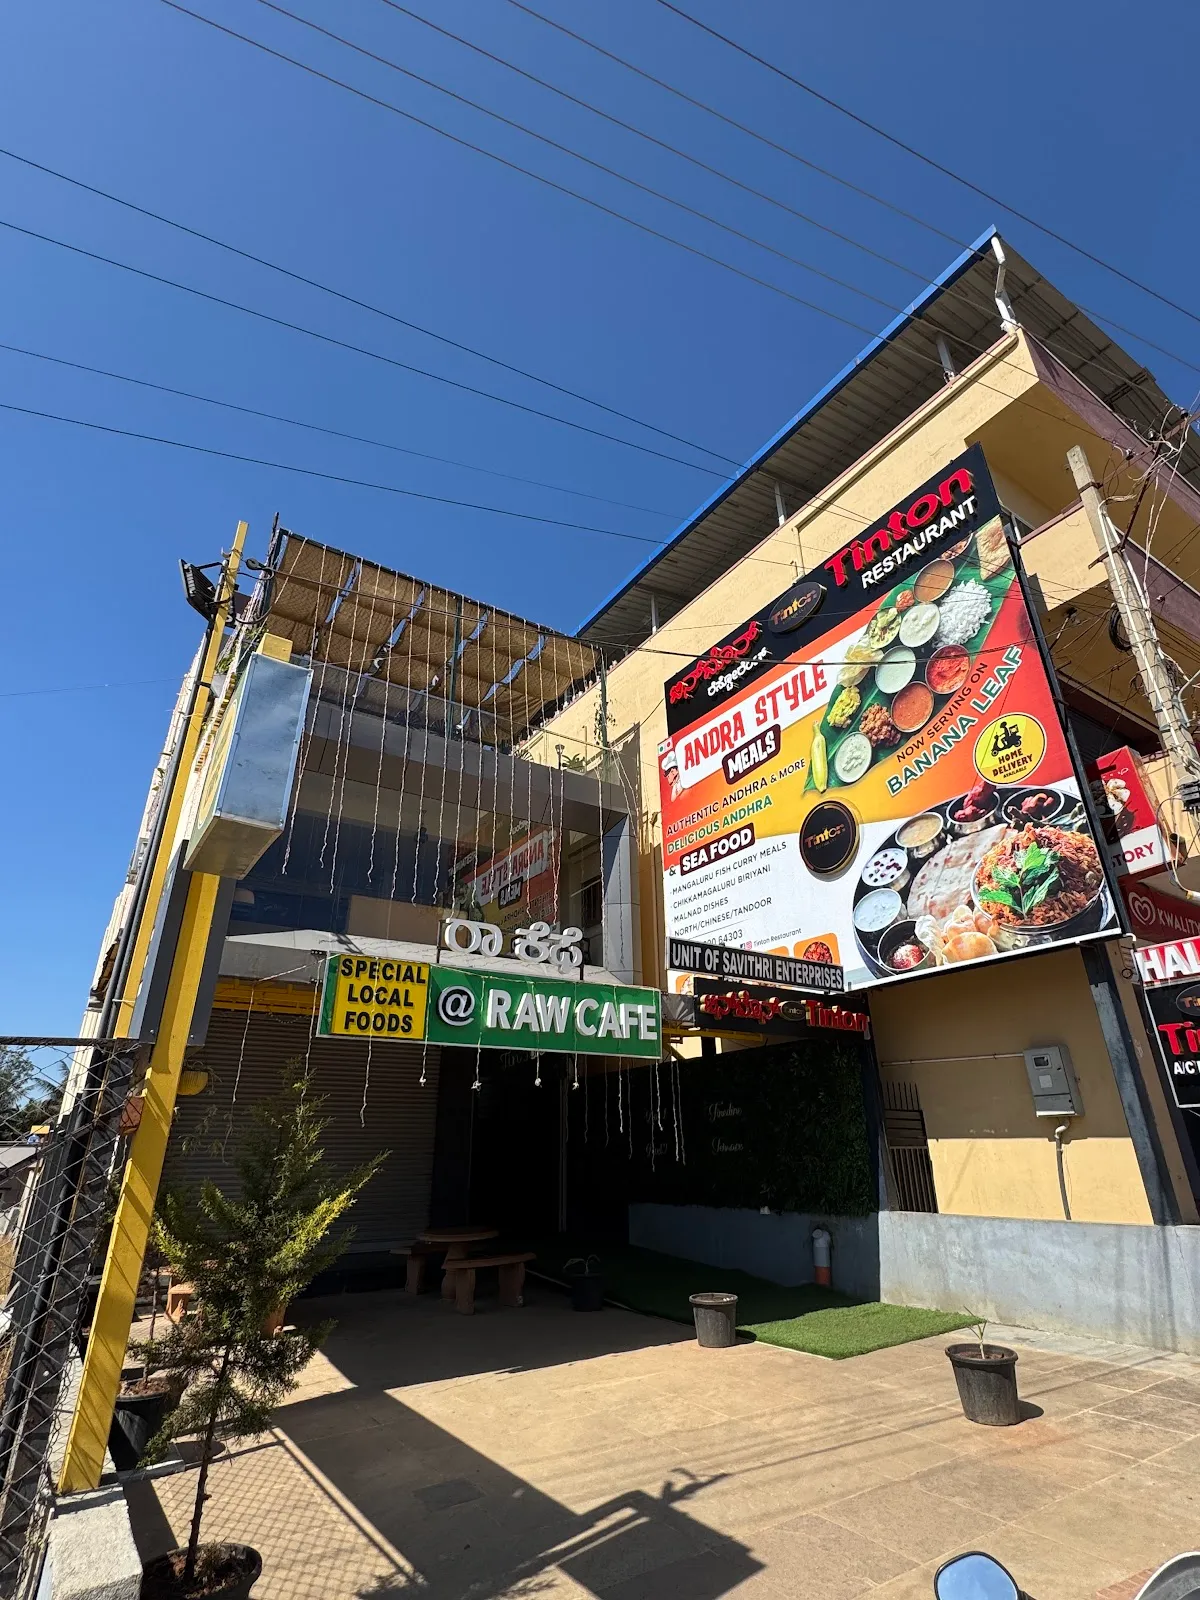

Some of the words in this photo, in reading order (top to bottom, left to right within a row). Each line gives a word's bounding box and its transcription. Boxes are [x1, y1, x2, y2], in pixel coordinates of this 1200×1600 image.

[824, 468, 974, 586] Tinton
[861, 495, 976, 589] RESTAURANT
[684, 711, 746, 770] ANDRA
[755, 660, 827, 727] STYLE
[886, 715, 978, 798] BANANA
[970, 645, 1023, 714] LEAF
[896, 736, 925, 763] NOW
[927, 686, 971, 739] SERVING
[970, 662, 988, 684] ON
[728, 730, 776, 779] MEALS
[992, 753, 1033, 777] DELIVERY
[998, 748, 1023, 764] HOME
[1003, 766, 1027, 778] AVAILABLE
[666, 801, 719, 836] AUTHENTIC
[722, 777, 768, 808] ANDHRA
[770, 774, 778, 783] &
[779, 758, 806, 779] MORE
[667, 820, 720, 854] DELICIOUS
[722, 795, 772, 828] ANDHRA
[668, 865, 677, 876] &
[682, 849, 708, 872] SEA
[710, 828, 752, 860] FOOD
[672, 873, 714, 895] MANGALURU
[715, 866, 731, 878] FISH
[732, 854, 758, 870] CURRY
[760, 841, 787, 858] MEALS
[673, 880, 736, 909] CHIKKAMAGALURU
[738, 864, 771, 884] BIRIYANI
[673, 907, 702, 923] MALNAD
[703, 897, 729, 912] DISHES
[674, 897, 772, 936] NORTH/CHINESE/TANDOOR
[445, 917, 503, 957] ರಾ
[719, 929, 743, 945] 64303
[753, 938, 770, 947] Tinton
[771, 928, 802, 941] Restaurant
[340, 957, 427, 984] SPECIAL
[672, 943, 701, 968] UNIT
[705, 948, 720, 971] OF
[722, 950, 773, 979] SAVITHRI
[776, 960, 843, 989] ENTERPRISES
[347, 984, 414, 1007] LOCAL
[438, 985, 475, 1027] @
[486, 988, 571, 1033] RAW
[575, 998, 658, 1041] CAFE
[806, 1000, 867, 1032] Tinton
[343, 1010, 413, 1033] FOODS
